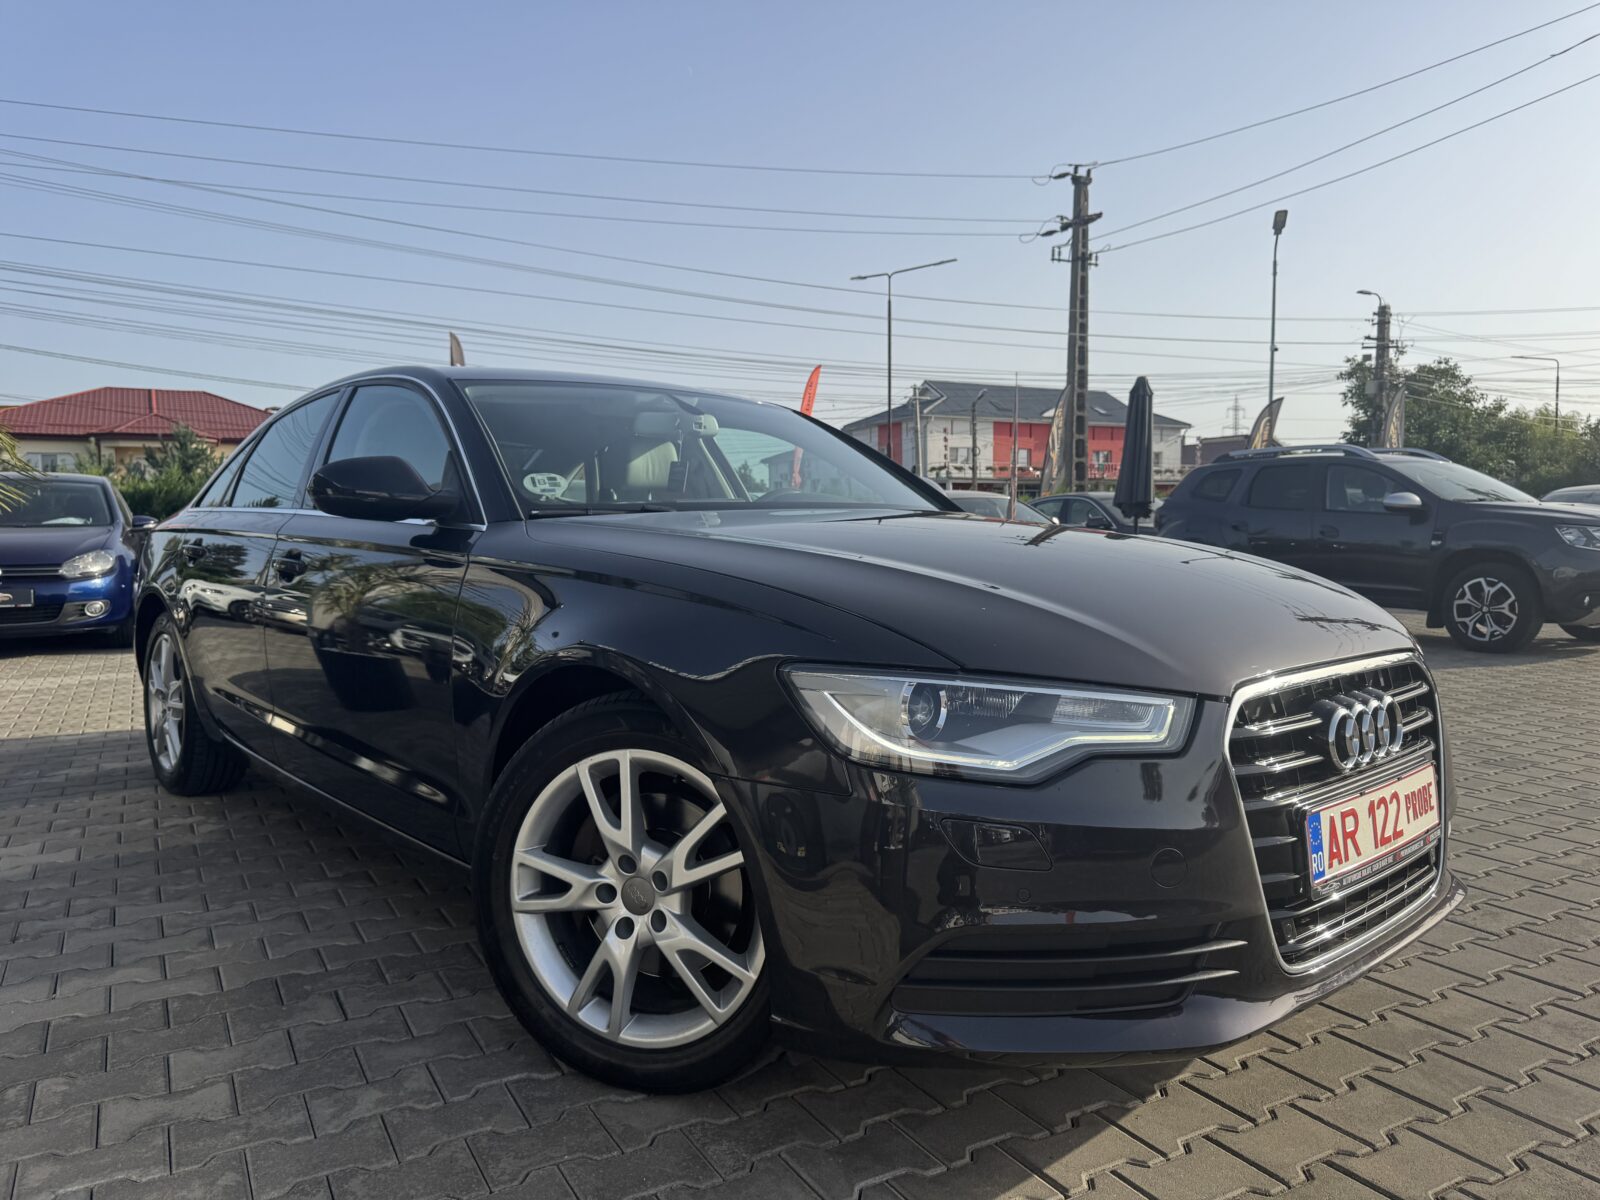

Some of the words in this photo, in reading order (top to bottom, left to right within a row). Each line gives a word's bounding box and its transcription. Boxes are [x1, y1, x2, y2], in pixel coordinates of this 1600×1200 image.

[1328, 807, 1362, 869] AR
[1368, 791, 1404, 849] 122
[1404, 782, 1434, 824] PROBE
[1312, 851, 1324, 875] RO
